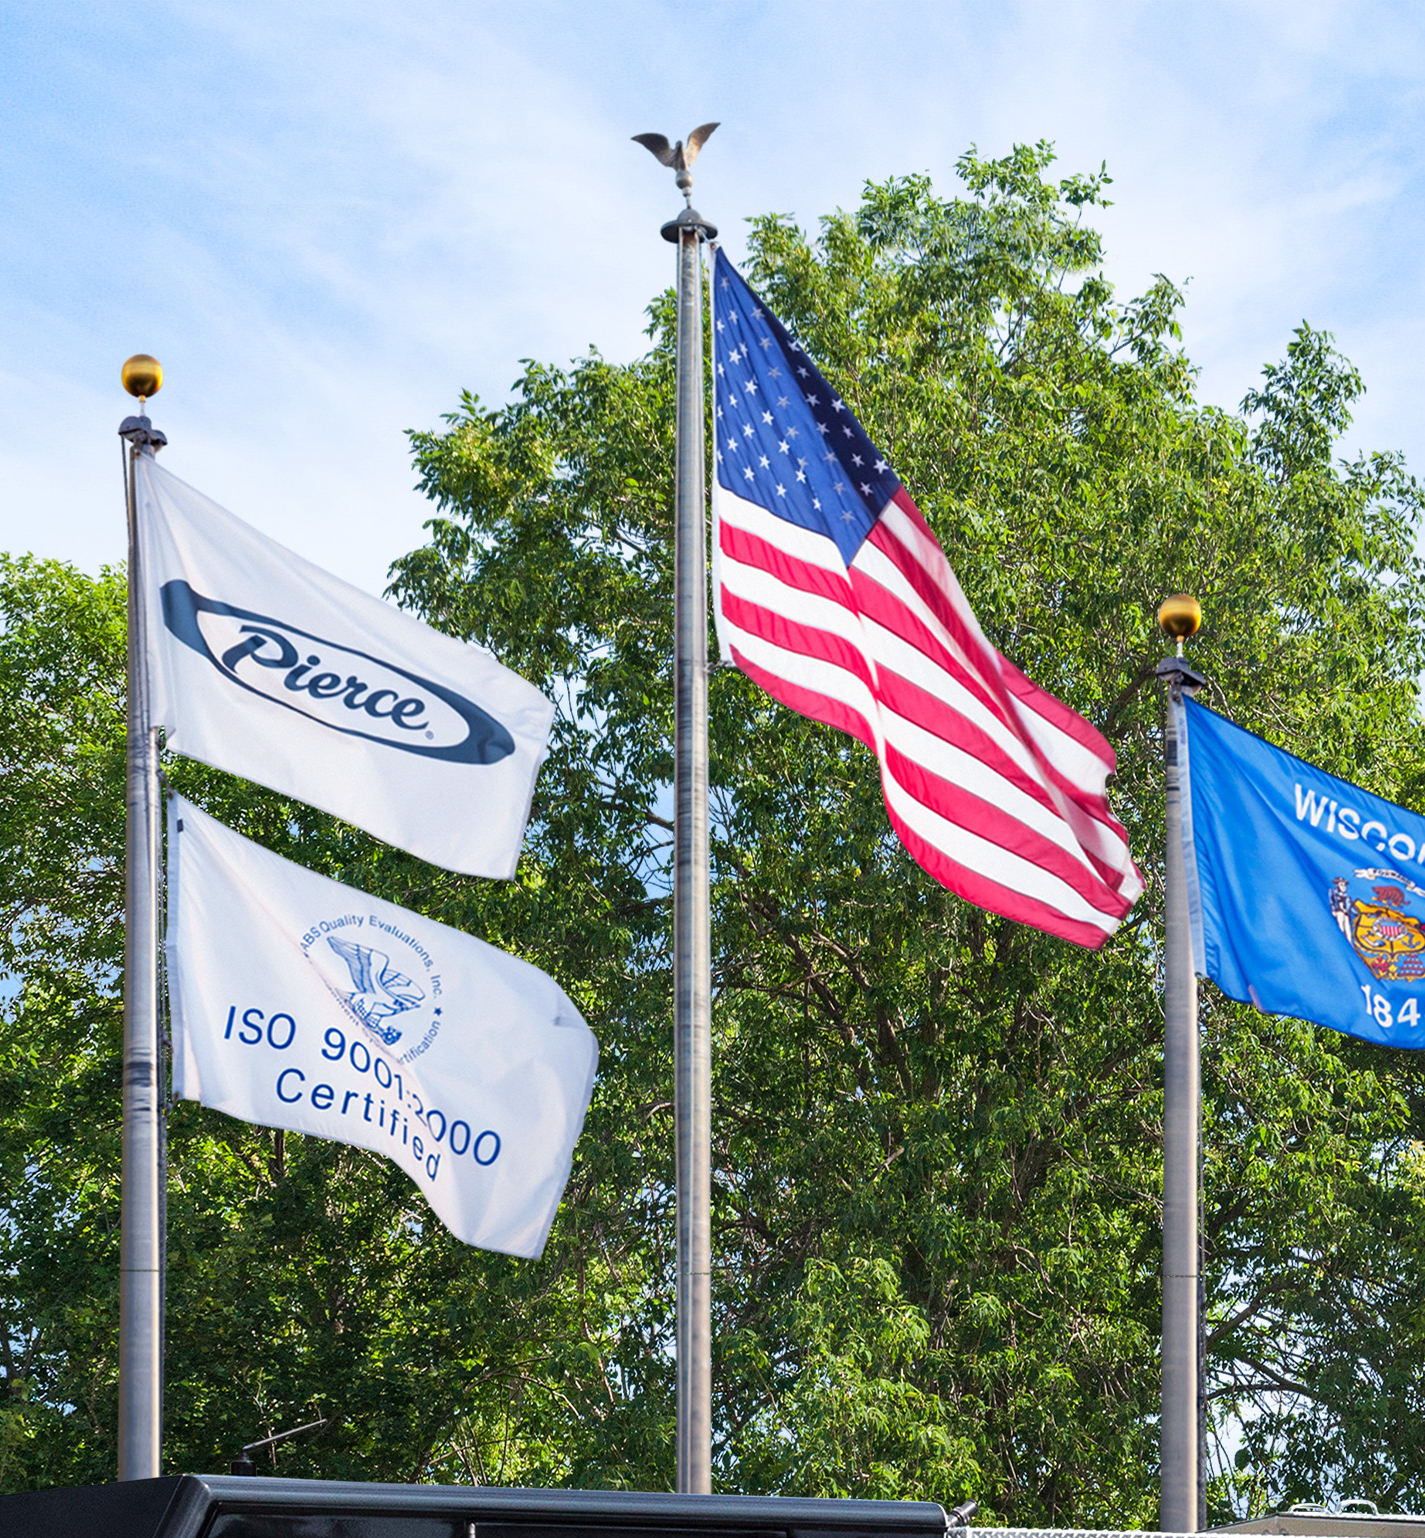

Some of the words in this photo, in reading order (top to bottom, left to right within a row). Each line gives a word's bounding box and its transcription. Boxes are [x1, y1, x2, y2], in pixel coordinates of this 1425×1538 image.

[221, 624, 430, 731] Pierce
[299, 926, 322, 951] ABS
[318, 914, 364, 933] Quality
[369, 914, 434, 972] Evaluations,
[430, 974, 443, 999] Inc.
[223, 1004, 297, 1050] ISO
[276, 1068, 442, 1182] Certified
[321, 1027, 502, 1166] 9001:2000
